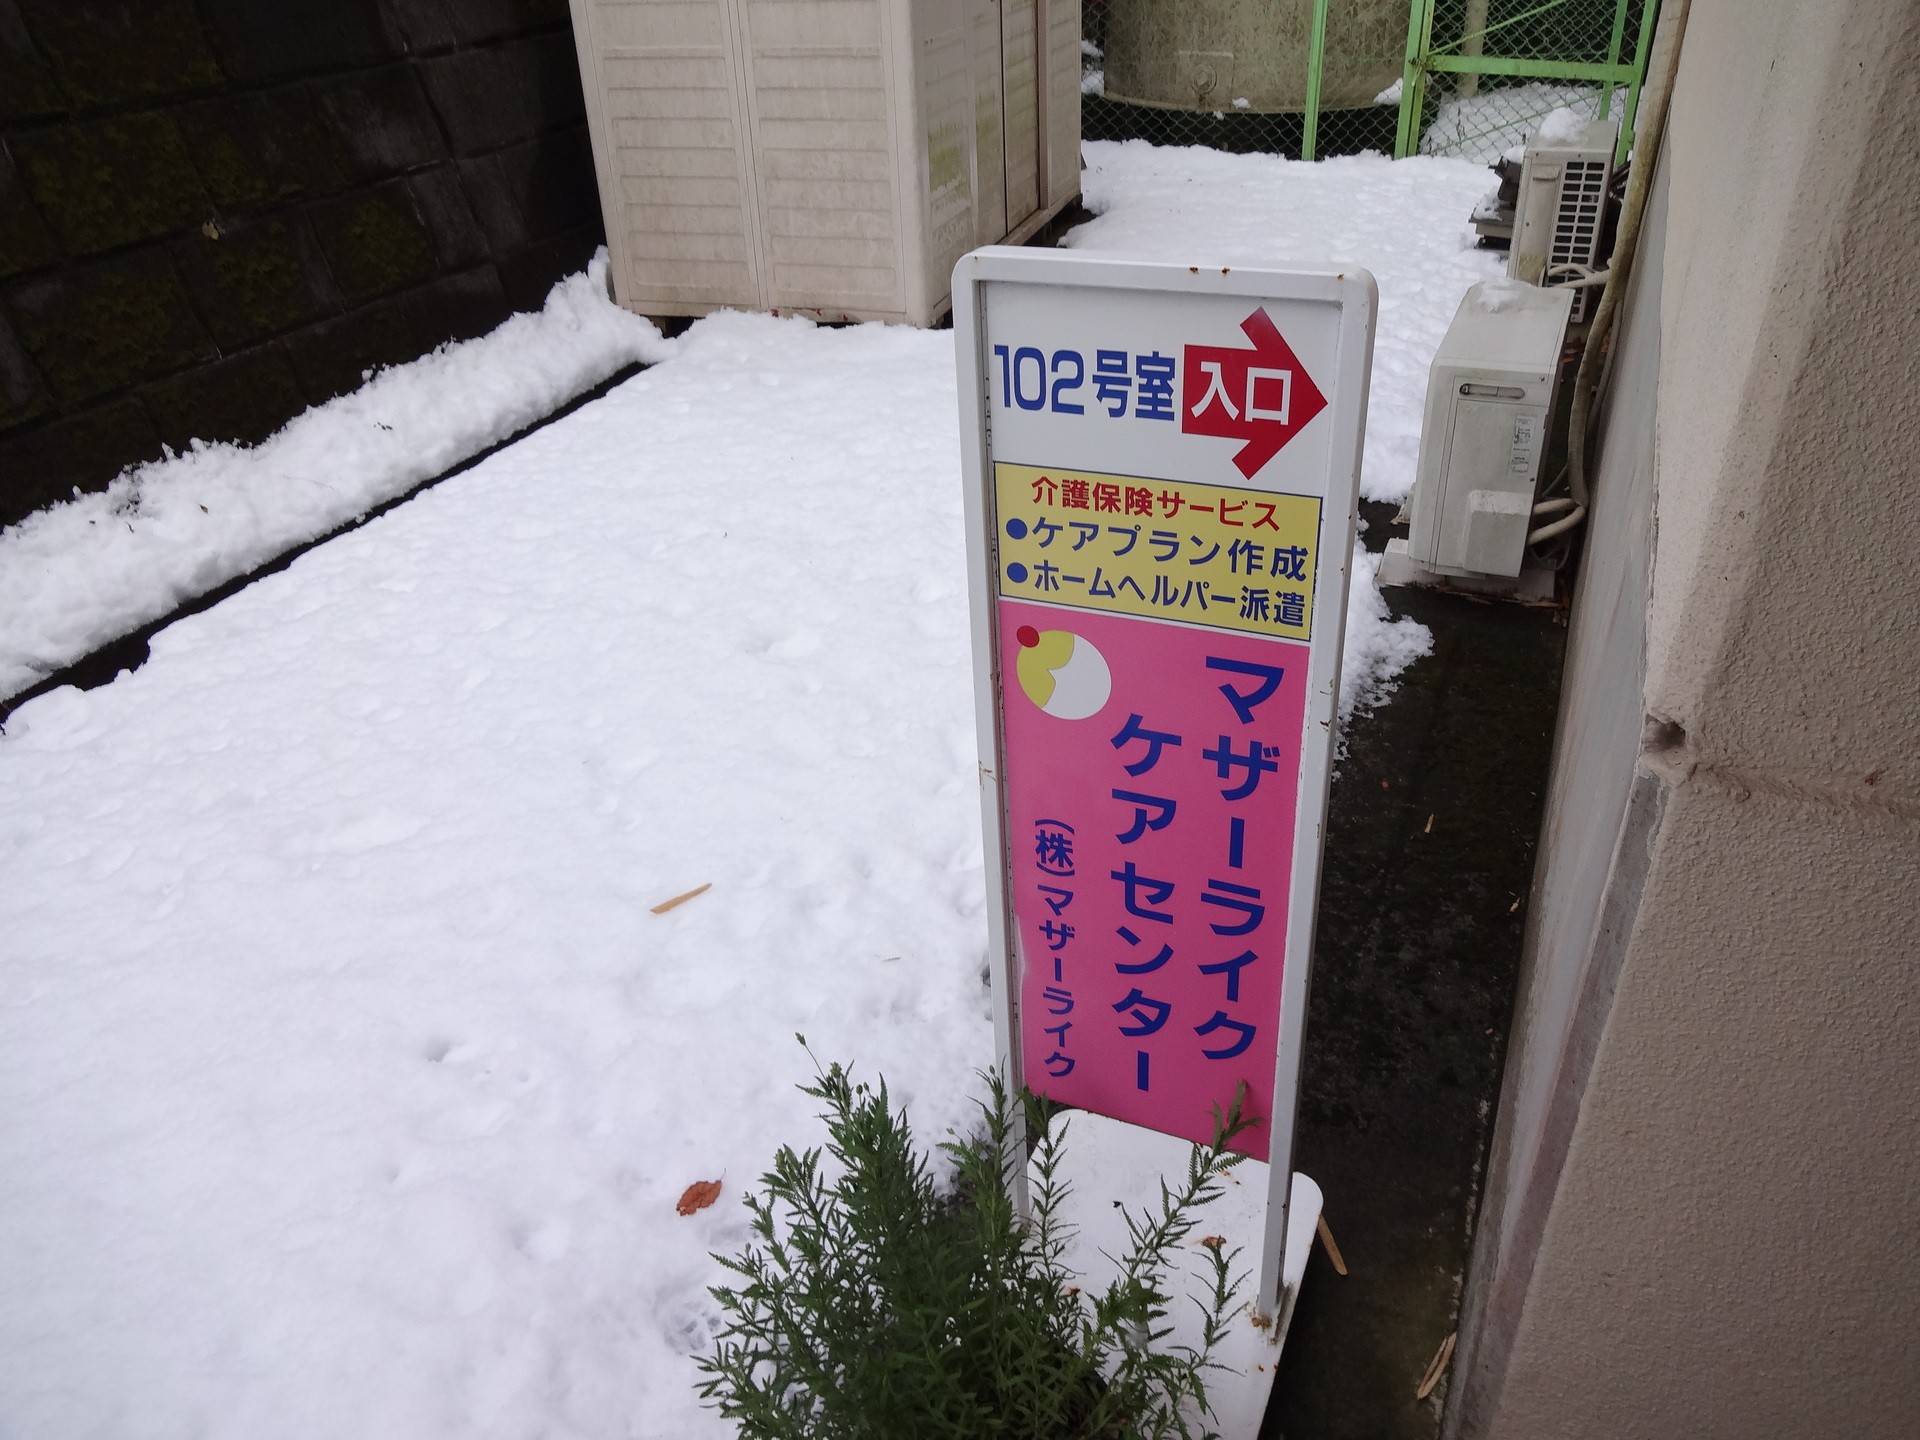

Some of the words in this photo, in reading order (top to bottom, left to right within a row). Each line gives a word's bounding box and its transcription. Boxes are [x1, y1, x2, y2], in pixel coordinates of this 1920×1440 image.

[994, 344, 1176, 421] 102号室
[1190, 361, 1291, 425] 入口
[1031, 476, 1280, 531] 介護保険サービス
[1194, 656, 1284, 1060] マザーライク
[1110, 713, 1182, 1092] ケアセンター
